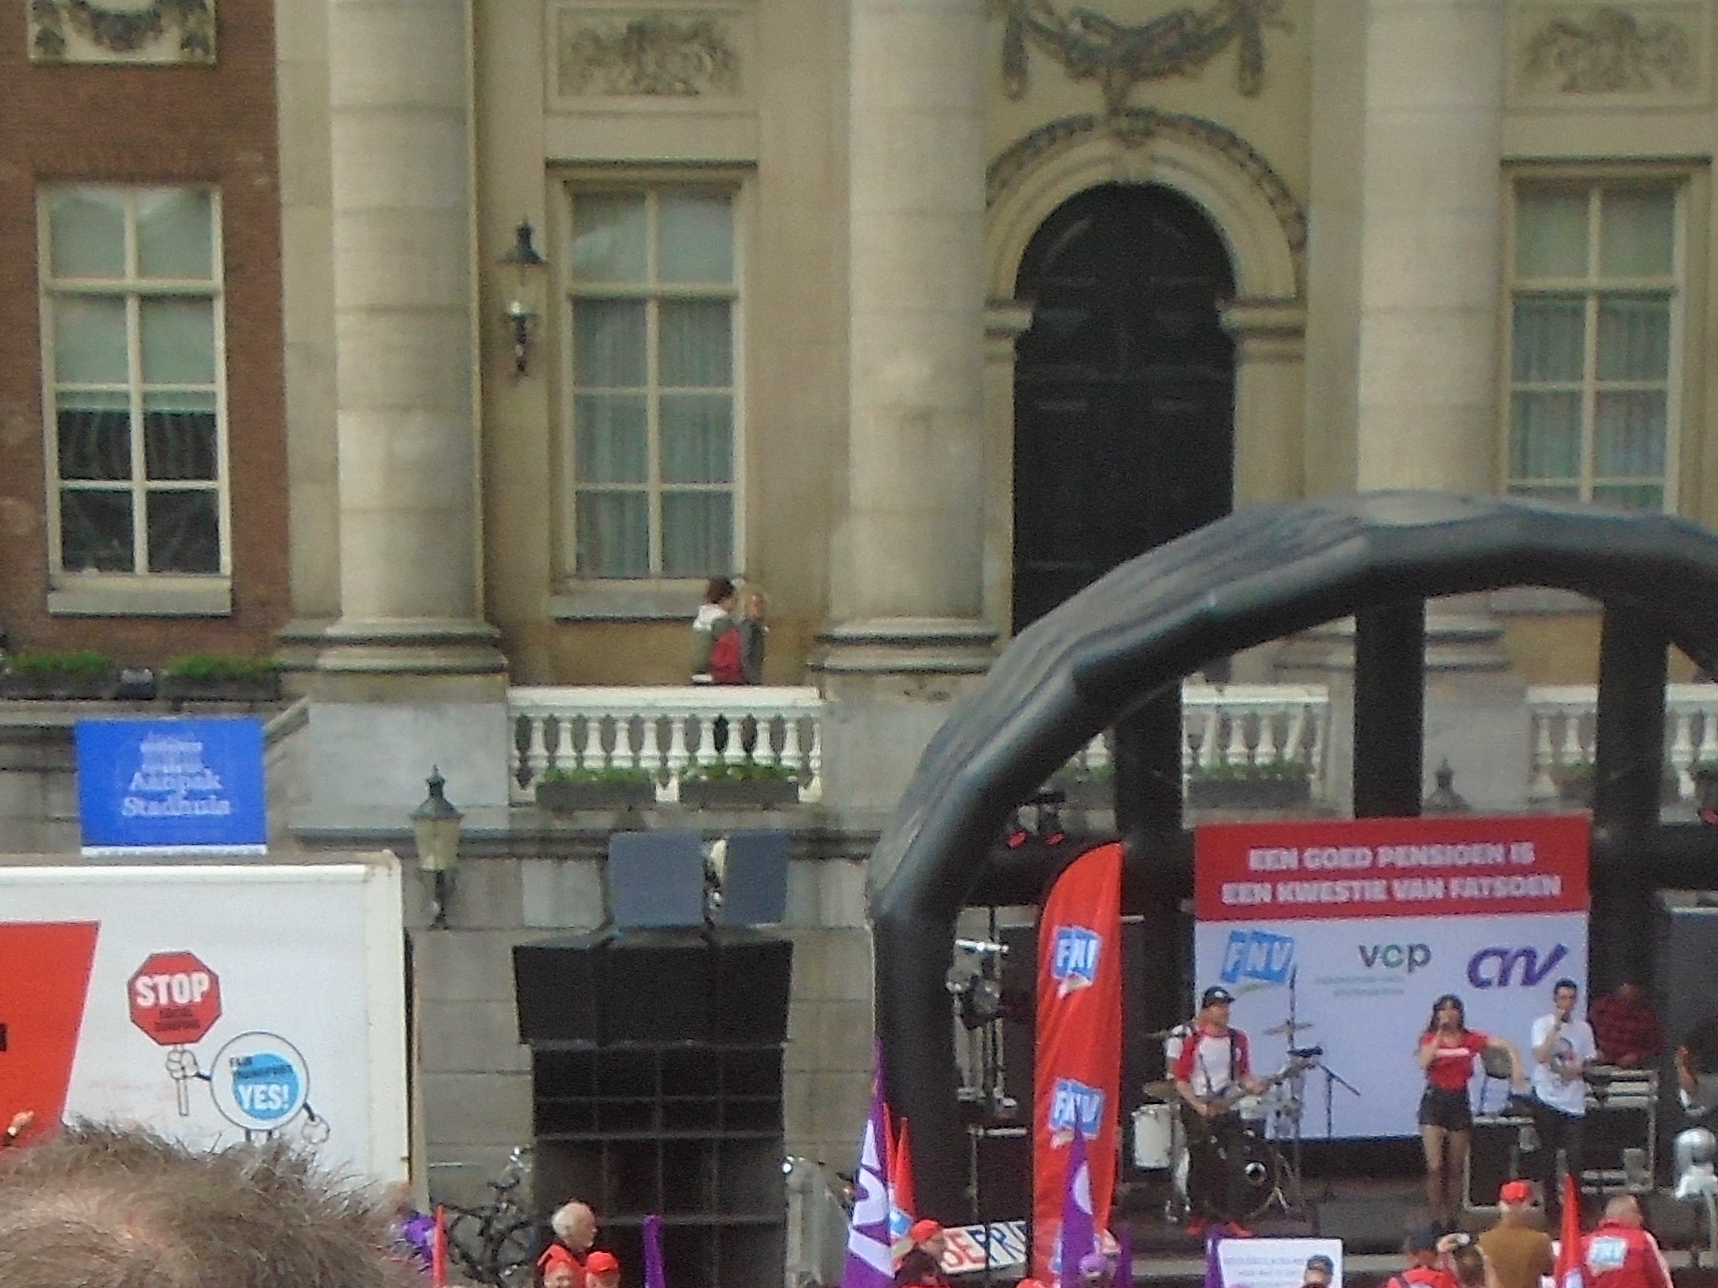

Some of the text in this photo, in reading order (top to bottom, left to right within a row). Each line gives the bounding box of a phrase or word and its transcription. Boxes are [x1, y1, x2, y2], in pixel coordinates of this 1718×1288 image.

[1358, 942, 1432, 973] vcp
[135, 971, 210, 1007] STOP
[237, 1083, 290, 1112] YES!
